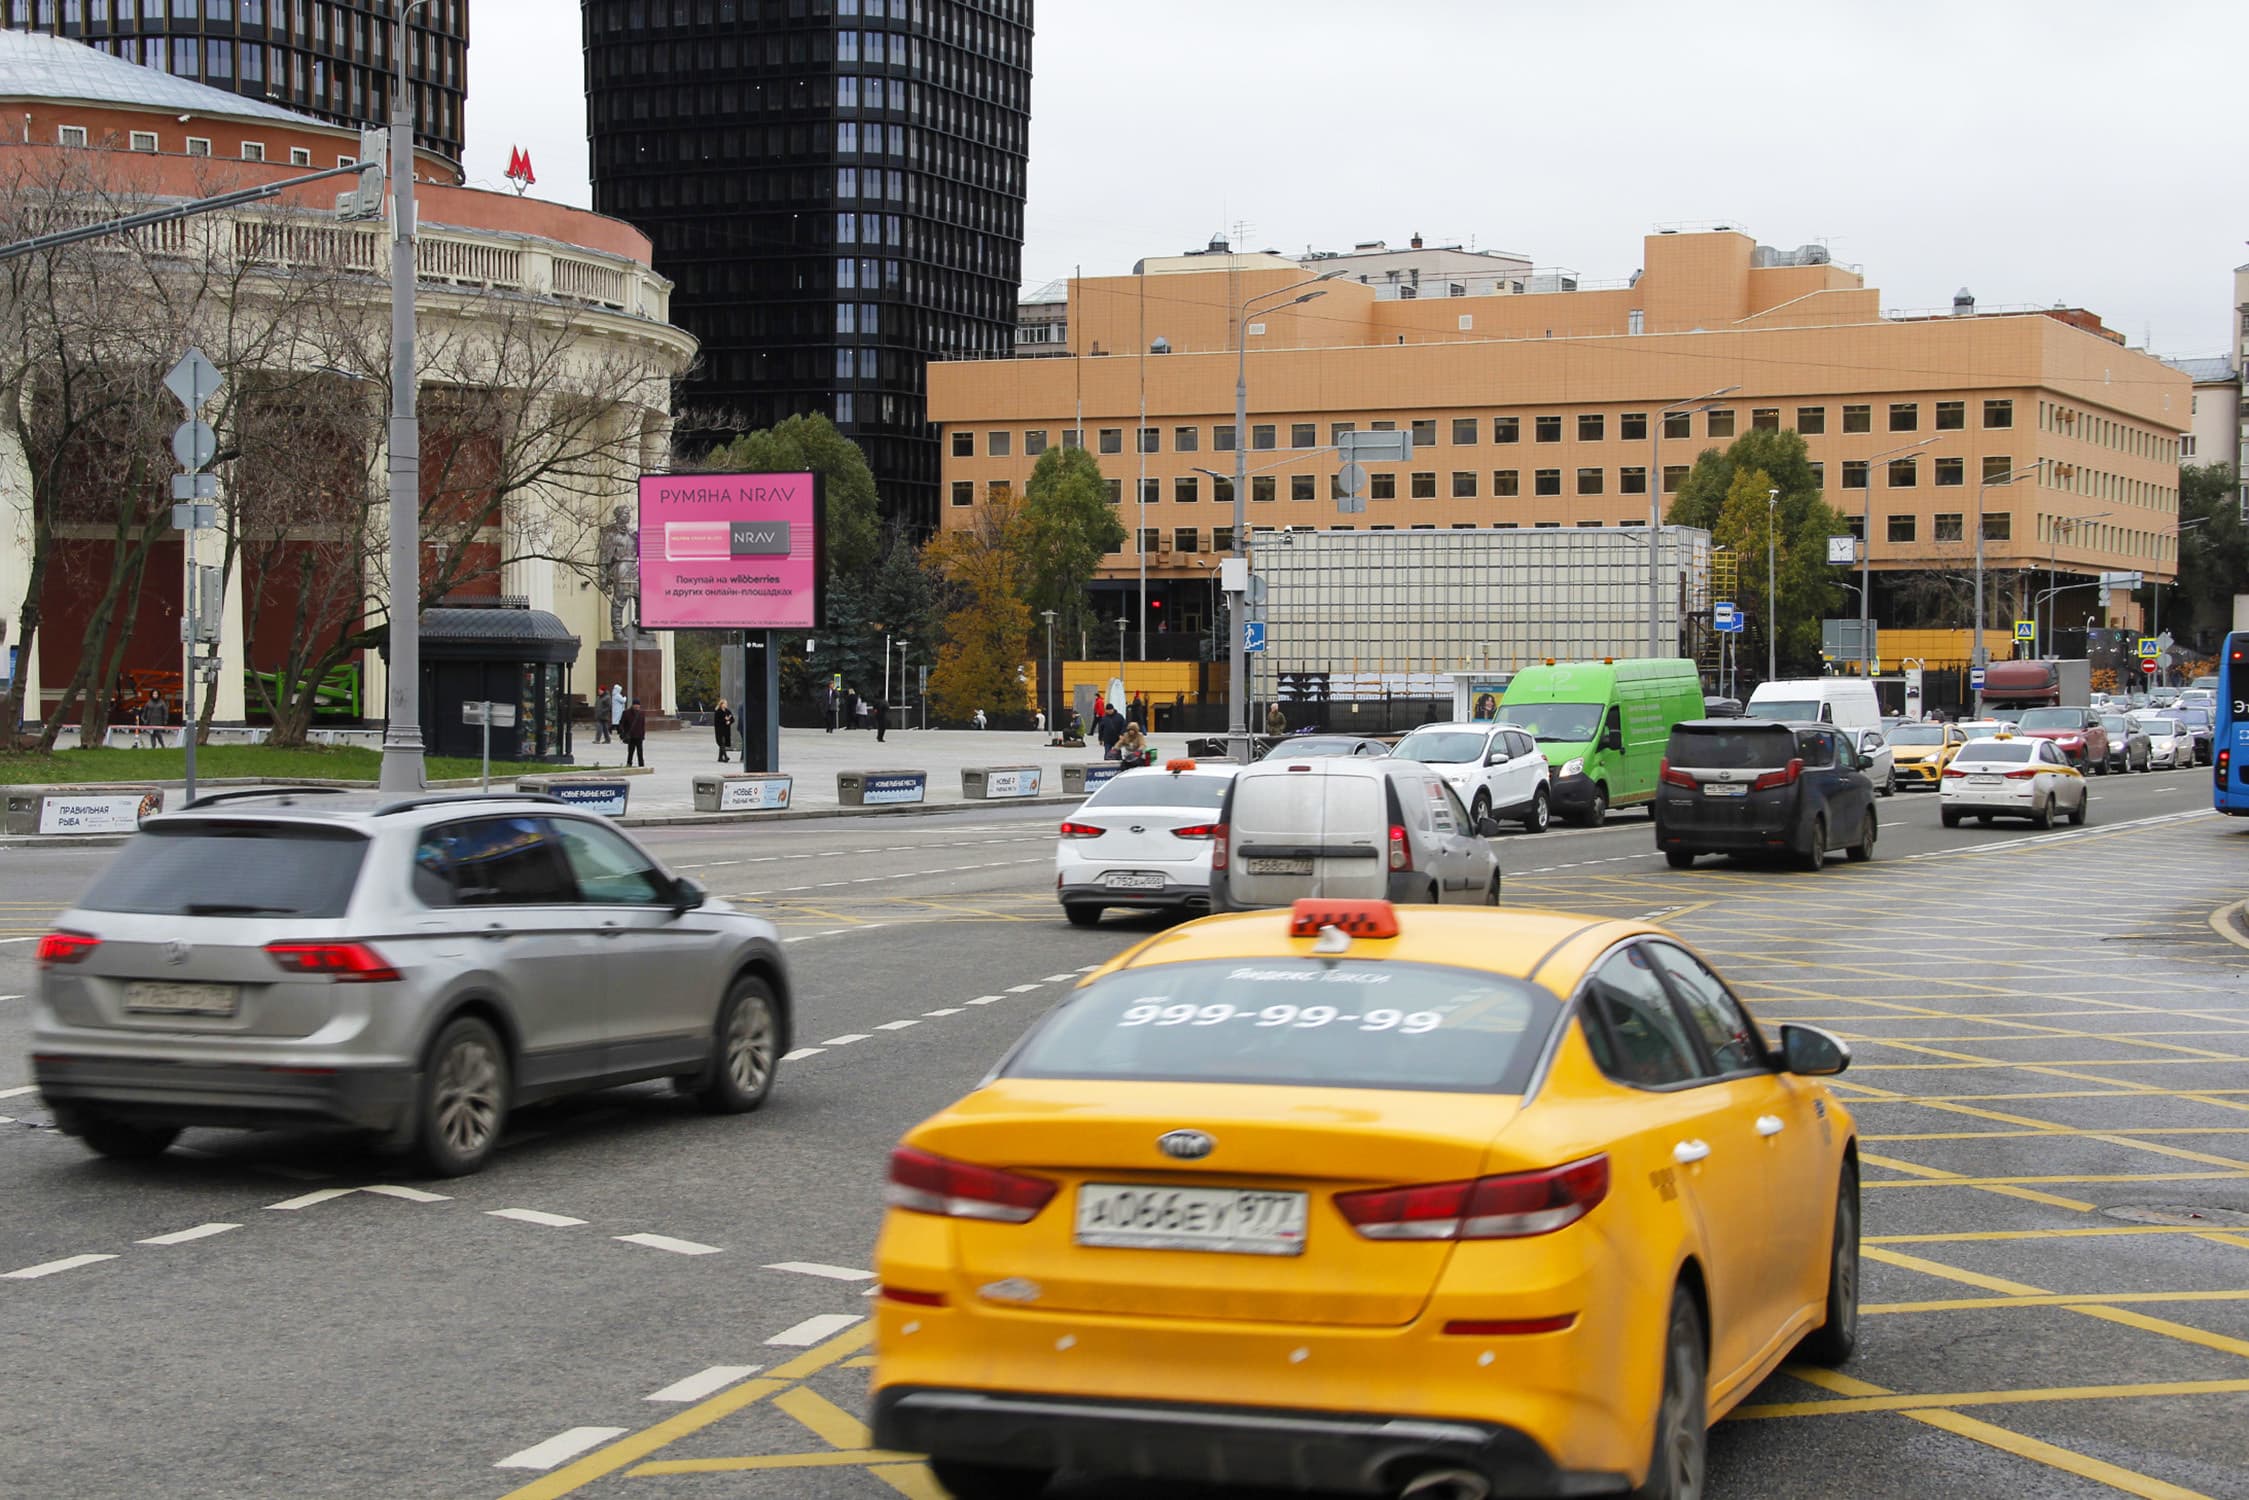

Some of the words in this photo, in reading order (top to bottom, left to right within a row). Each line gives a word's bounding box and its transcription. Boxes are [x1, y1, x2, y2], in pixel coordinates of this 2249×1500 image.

[660, 489, 732, 503] РУМЯНА
[740, 487, 796, 502] NRAV
[734, 531, 776, 544] NRAV
[676, 575, 714, 585] Покупай
[730, 575, 780, 584] wildberries
[672, 589, 703, 597] других
[704, 588, 793, 597] онлайн-площадках
[561, 790, 579, 798] НОВЫЕ
[580, 790, 599, 798] РЫБНЫЕ
[599, 789, 616, 797] МЕСТА
[59, 806, 109, 815] ПРАВИЛЬНАЯ
[58, 818, 80, 826] РЫБА
[1117, 1003, 1444, 1035] 999-99-99
